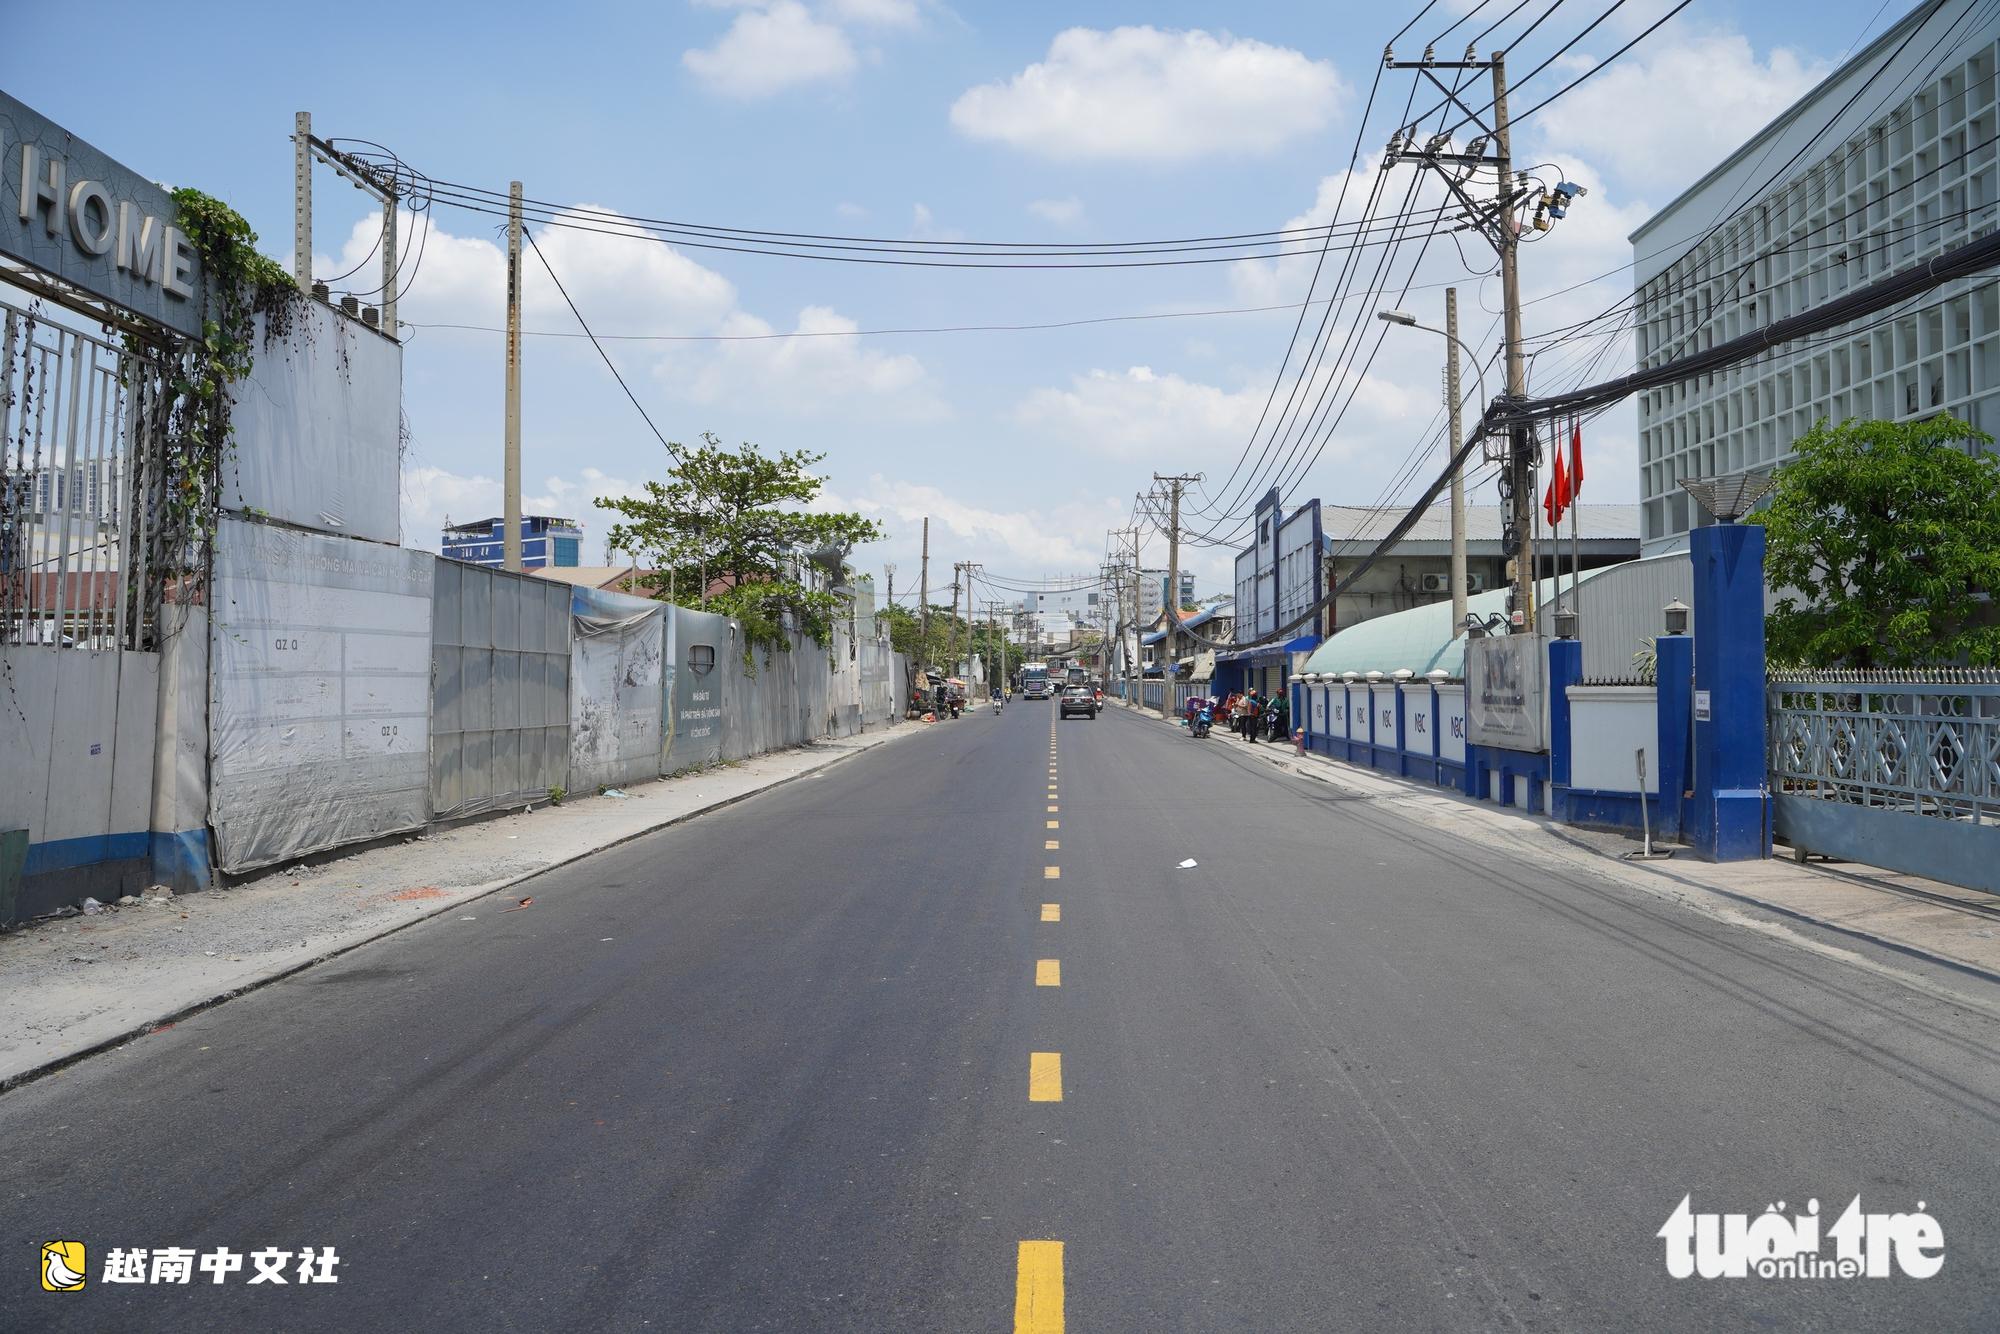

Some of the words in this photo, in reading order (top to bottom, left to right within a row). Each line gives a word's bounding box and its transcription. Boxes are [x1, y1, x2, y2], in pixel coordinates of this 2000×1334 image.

[20, 144, 193, 299] HOME
[1414, 712, 1426, 733] NBC
[1451, 716, 1464, 739] NBC
